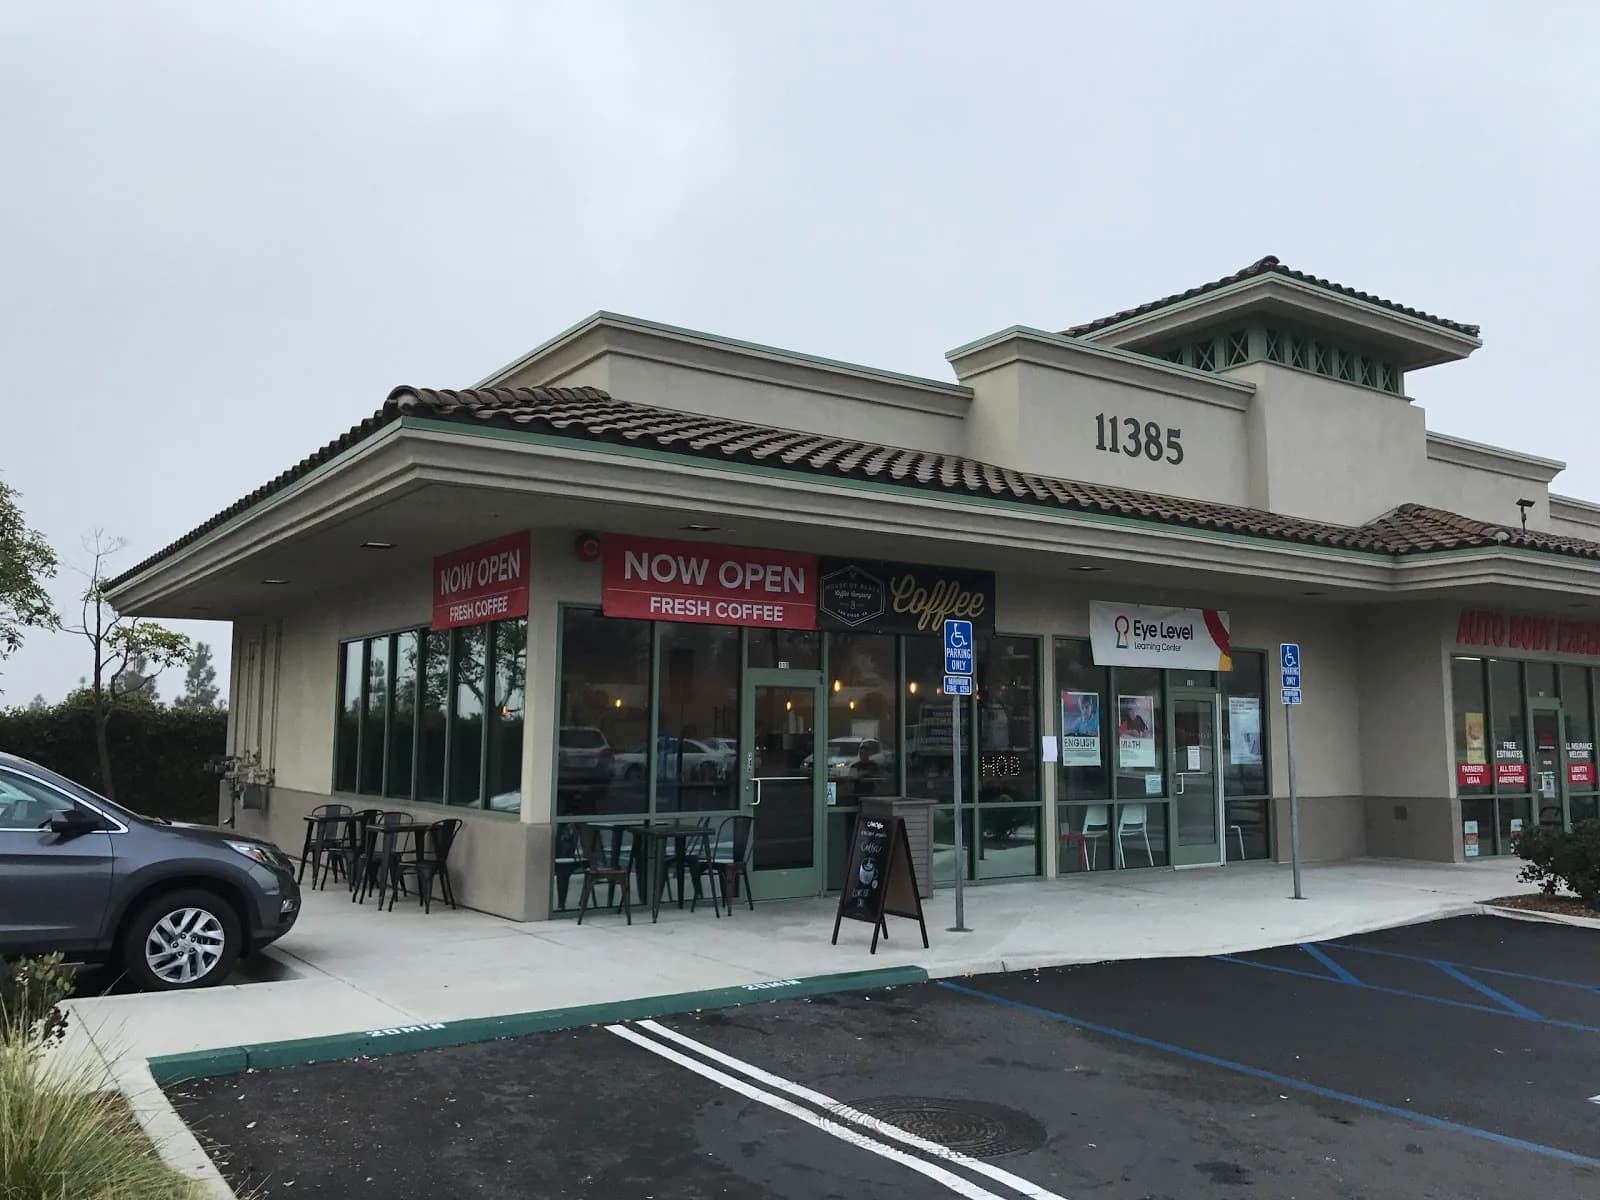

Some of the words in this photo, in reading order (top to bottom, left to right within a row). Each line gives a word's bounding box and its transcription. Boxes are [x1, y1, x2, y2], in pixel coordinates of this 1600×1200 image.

[1095, 412, 1184, 465] 11385
[440, 561, 476, 595] NOW
[477, 548, 521, 587] OPEN
[624, 550, 710, 587] NOW
[718, 561, 807, 597] OPEN
[449, 600, 474, 622] FRESH
[474, 595, 509, 618] COFFEE
[650, 597, 710, 618] FRESH
[714, 601, 784, 622] COFFEE
[890, 574, 985, 632] Coffee
[1133, 619, 1157, 641] Eye
[1160, 621, 1194, 641] Level
[1456, 609, 1505, 648] AUTO
[1509, 613, 1554, 651] BODY
[946, 647, 971, 659] PARKING
[1134, 641, 1161, 652] Learning
[1161, 643, 1181, 652] Center
[951, 659, 967, 671] ONLY
[1063, 738, 1095, 748] ENGLISH
[1120, 740, 1141, 750] MATH
[1503, 741, 1516, 750] FREE
[1496, 750, 1523, 758] ESTIMATES
[982, 755, 1020, 777] HOB
[1461, 765, 1484, 773] FARMERS
[1466, 776, 1480, 784] USAA
